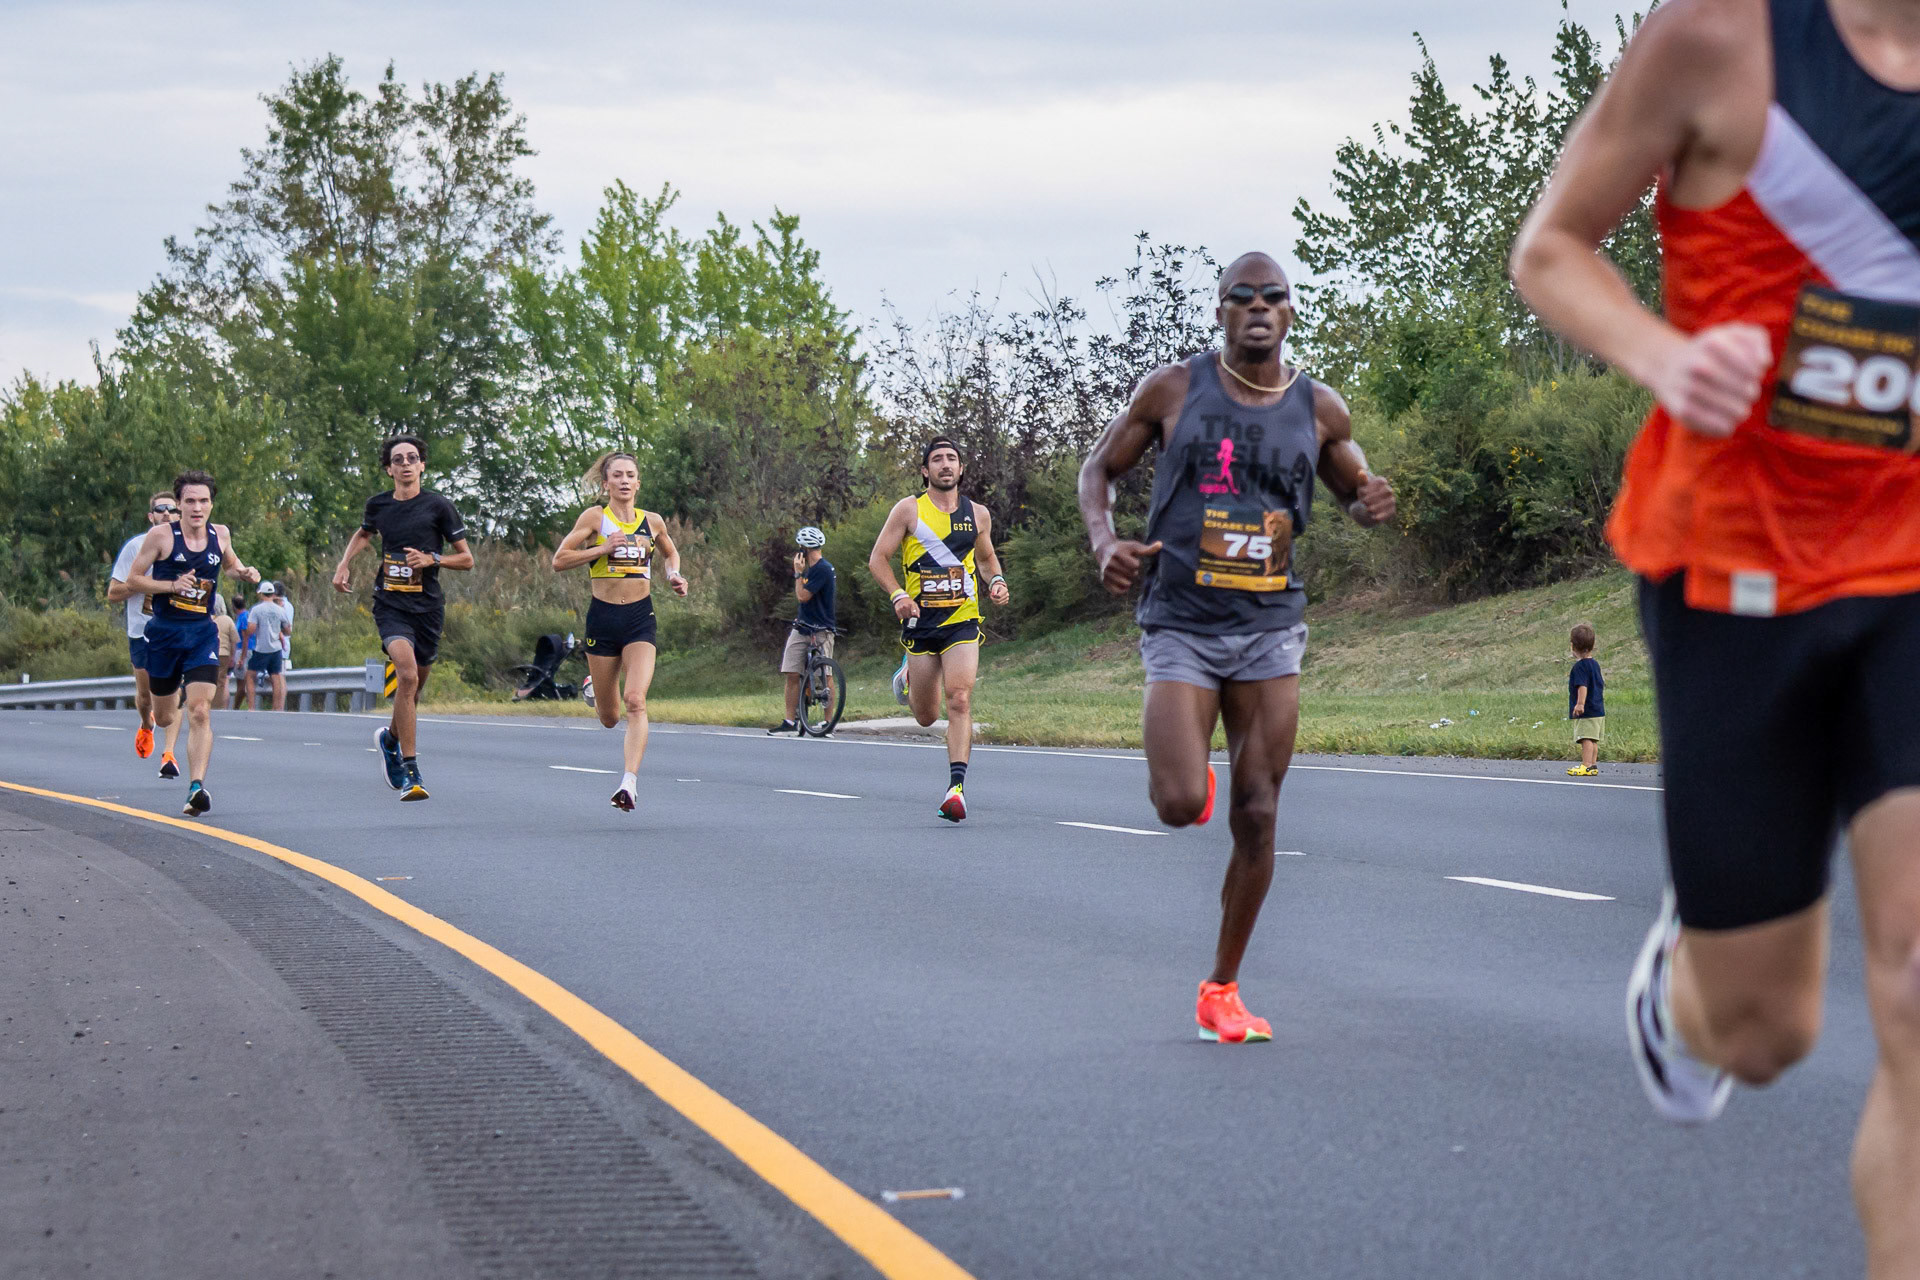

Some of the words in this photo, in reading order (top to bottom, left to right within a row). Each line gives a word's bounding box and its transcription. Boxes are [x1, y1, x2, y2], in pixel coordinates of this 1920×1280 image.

[1200, 415, 1265, 442] The
[953, 523, 973, 532] GSTC
[614, 546, 646, 559] 251
[1223, 532, 1273, 560] 75
[208, 552, 220, 566] SP
[388, 565, 413, 577] 29
[923, 579, 962, 592] 245
[181, 588, 207, 600] 37
